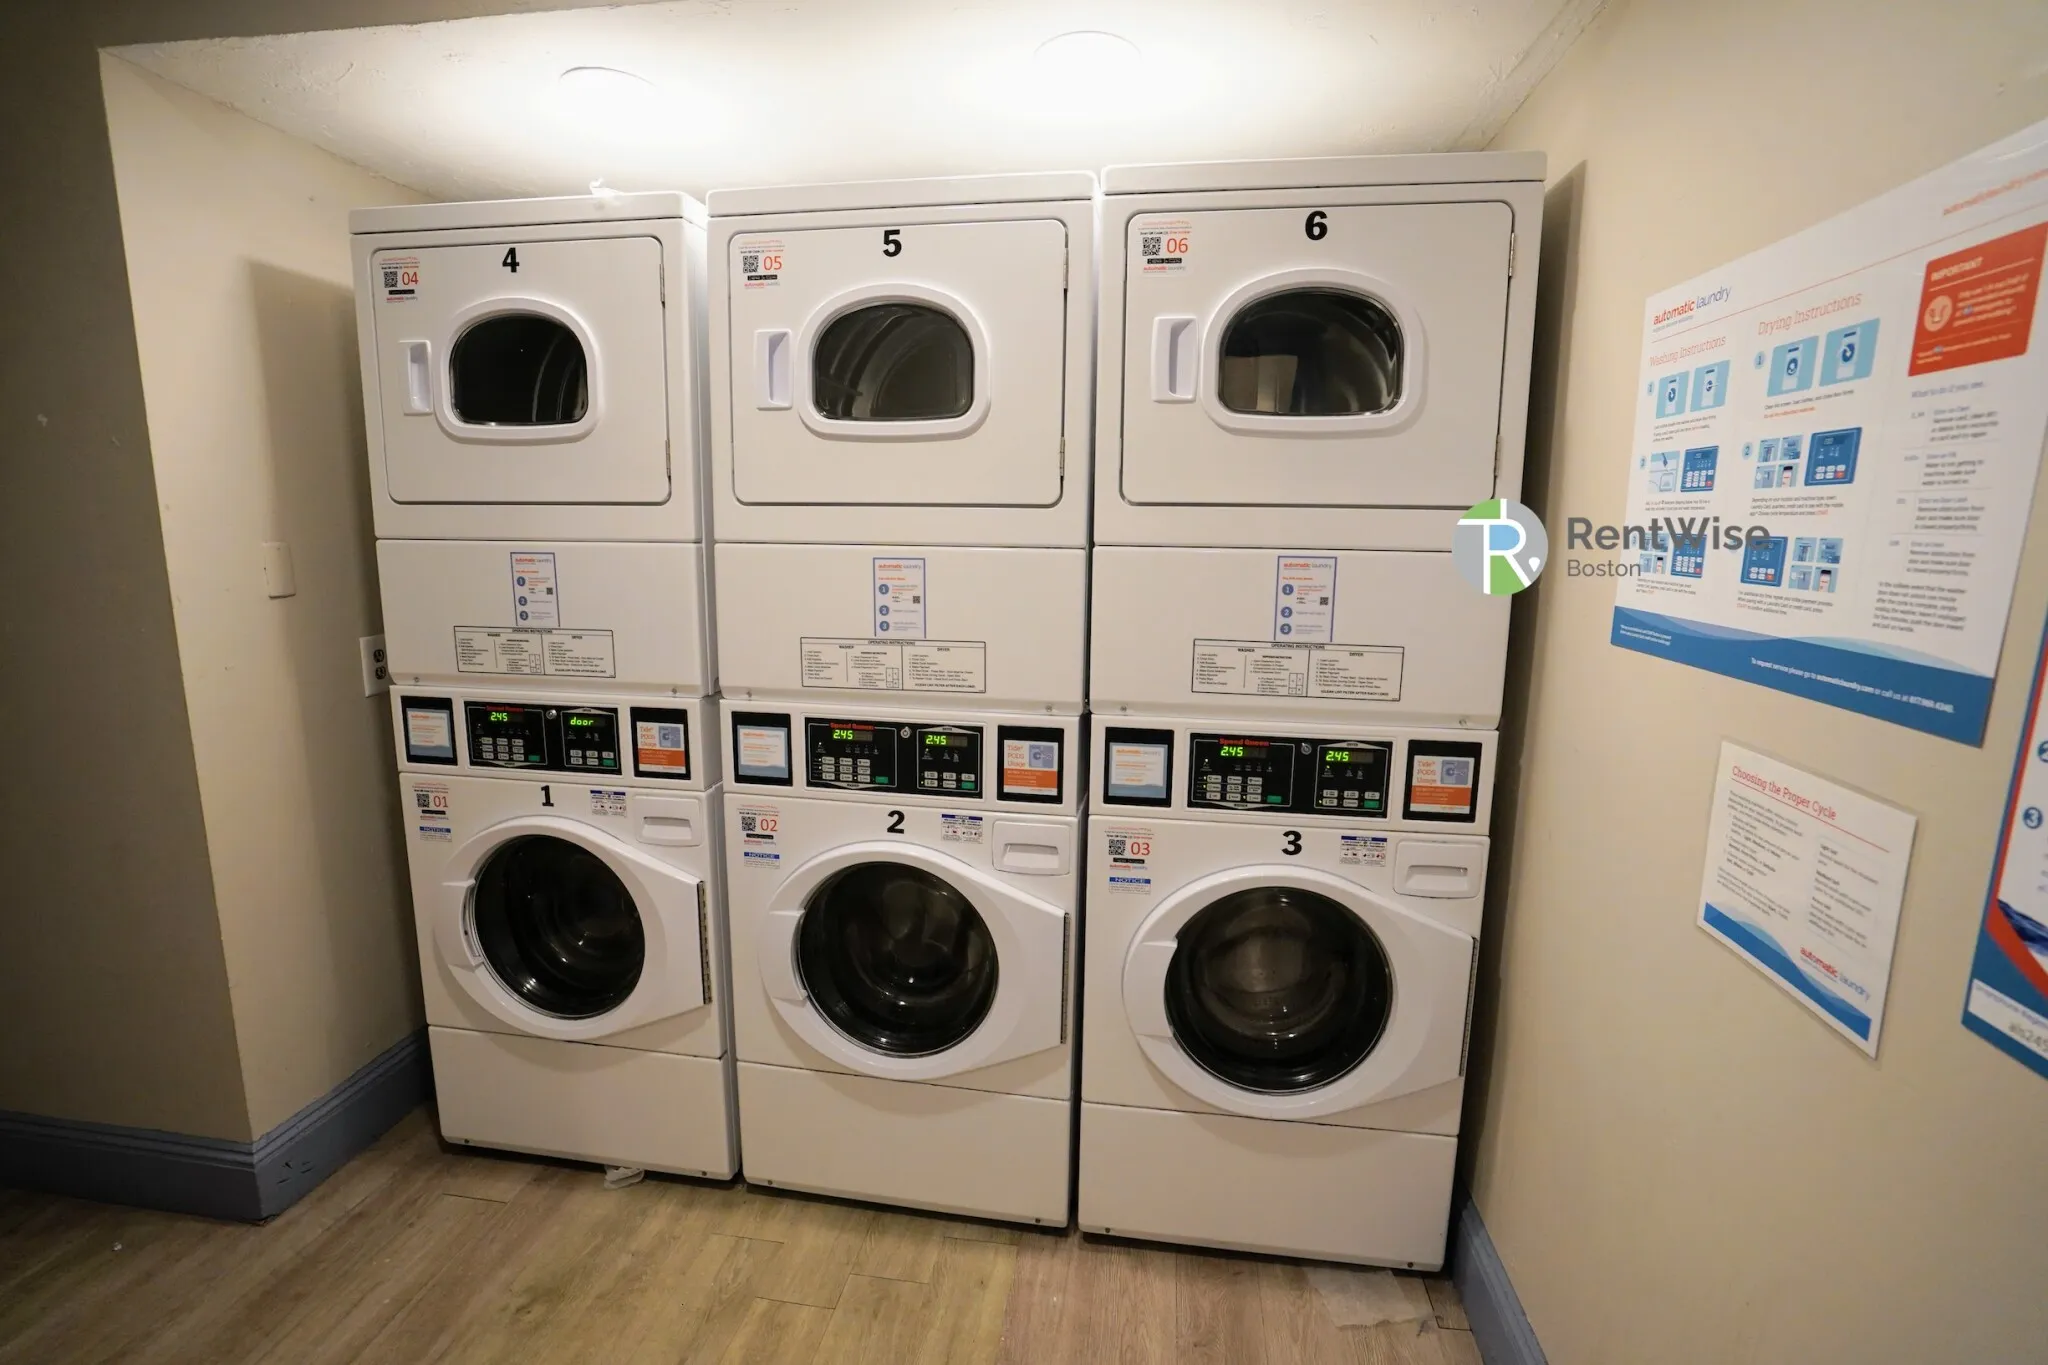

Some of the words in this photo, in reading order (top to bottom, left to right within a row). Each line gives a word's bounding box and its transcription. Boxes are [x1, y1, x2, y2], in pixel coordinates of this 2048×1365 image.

[1305, 210, 1328, 241] 6
[882, 229, 902, 257] 5
[1167, 237, 1188, 254] 06
[502, 247, 520, 273] 4
[763, 256, 783, 271] 05
[402, 271, 419, 286] 04
[1653, 300, 1695, 325] automatic
[1696, 285, 1732, 309] laundry
[1758, 316, 1792, 335] Drying
[1793, 293, 1863, 324] Instructions
[1650, 351, 1679, 366] Washing
[1680, 336, 1726, 358] Instructions
[570, 717, 594, 726] door
[433, 795, 449, 808] 01
[541, 785, 554, 807] 1
[1732, 766, 1767, 791] Choosing
[1768, 781, 1781, 795] the
[1783, 787, 1810, 808] Proper
[1812, 800, 1837, 820] Cycle
[760, 818, 778, 832] 02
[887, 810, 905, 834] 2
[1130, 841, 1151, 856] 03
[1281, 830, 1302, 856] 3
[1800, 946, 1838, 978] automatic
[1840, 974, 1871, 1003] laundry
